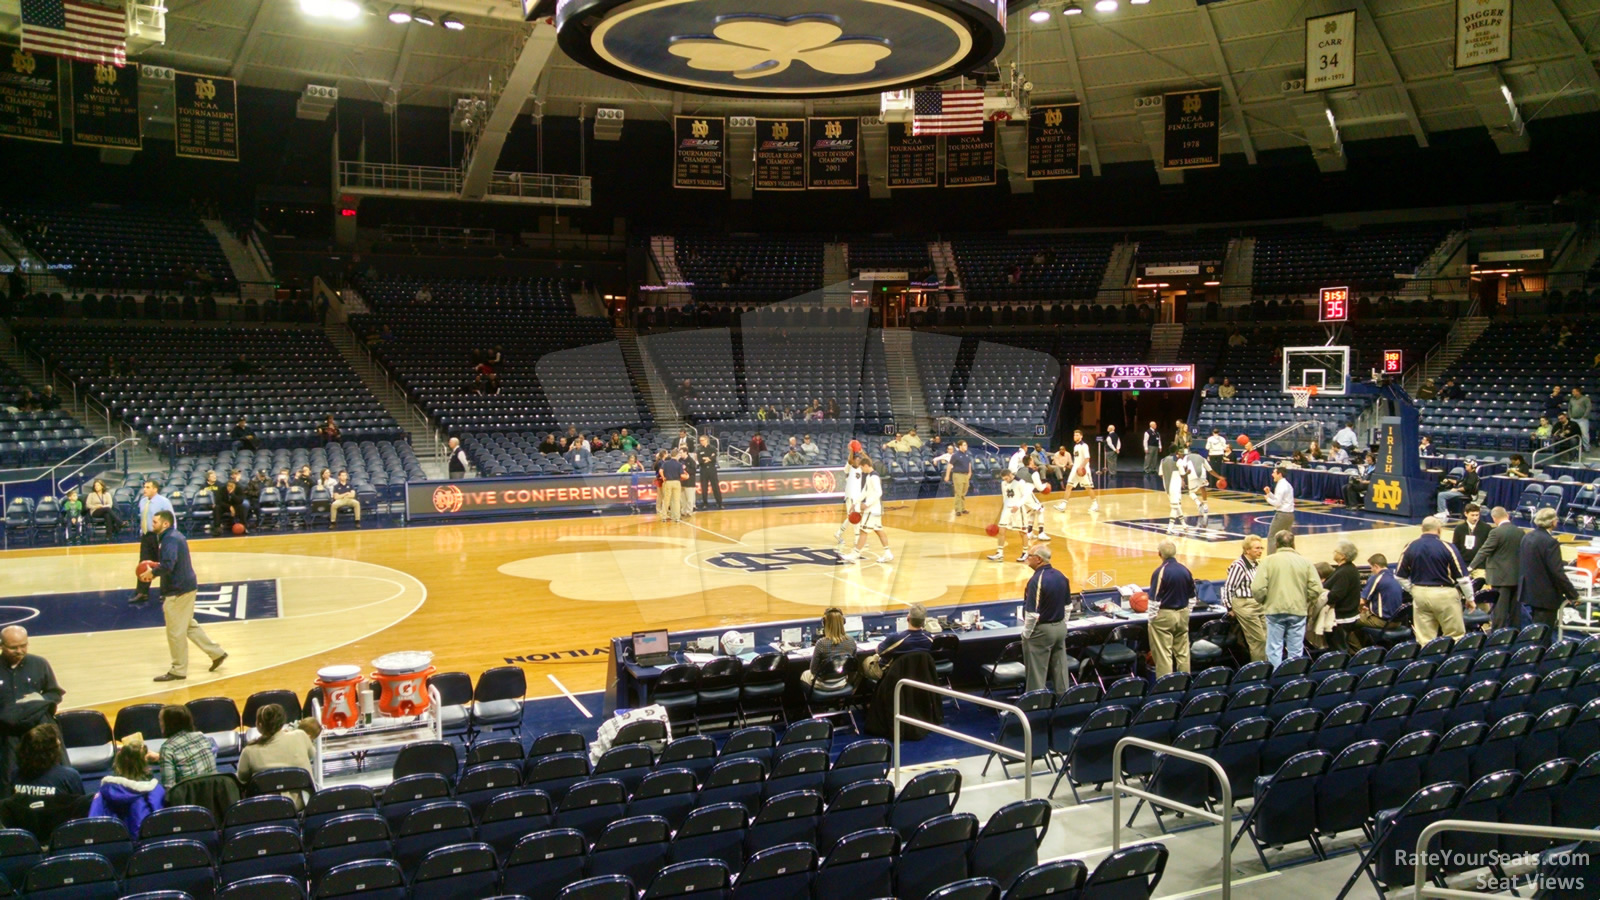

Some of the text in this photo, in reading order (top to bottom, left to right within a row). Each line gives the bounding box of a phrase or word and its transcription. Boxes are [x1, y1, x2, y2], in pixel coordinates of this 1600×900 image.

[1463, 9, 1504, 25] DIGGER
[1465, 18, 1502, 33] PHELPS
[1318, 38, 1342, 48] CARR
[1320, 53, 1339, 70] 34
[93, 86, 120, 96] NCAA
[5, 95, 46, 107] CHAMPION
[84, 93, 117, 105] SWEET
[194, 101, 219, 110] NCAA
[178, 107, 234, 120] TOURNAMENT
[1181, 115, 1203, 123] NCAA
[1168, 121, 1216, 131] FINAL FOUR
[1043, 128, 1065, 136] NCAA
[1036, 135, 1062, 143] SWEET
[1183, 140, 1200, 148] 1978
[890, 144, 936, 152] TOURNAMENT
[948, 142, 993, 151] TOURNAMENT
[678, 150, 722, 158] TOURNAMENT
[683, 156, 717, 164] CHAMPION
[826, 164, 841, 172] 2001
[1327, 300, 1344, 318] 35
[1387, 361, 1397, 370] 35
[1117, 366, 1146, 377] 31:52
[1081, 375, 1089, 385] 0
[1175, 373, 1183, 384] 0
[1384, 426, 1394, 473] IRISH
[504, 485, 630, 505] CONFERENCE
[719, 480, 742, 494] OF
[745, 479, 777, 493] THE
